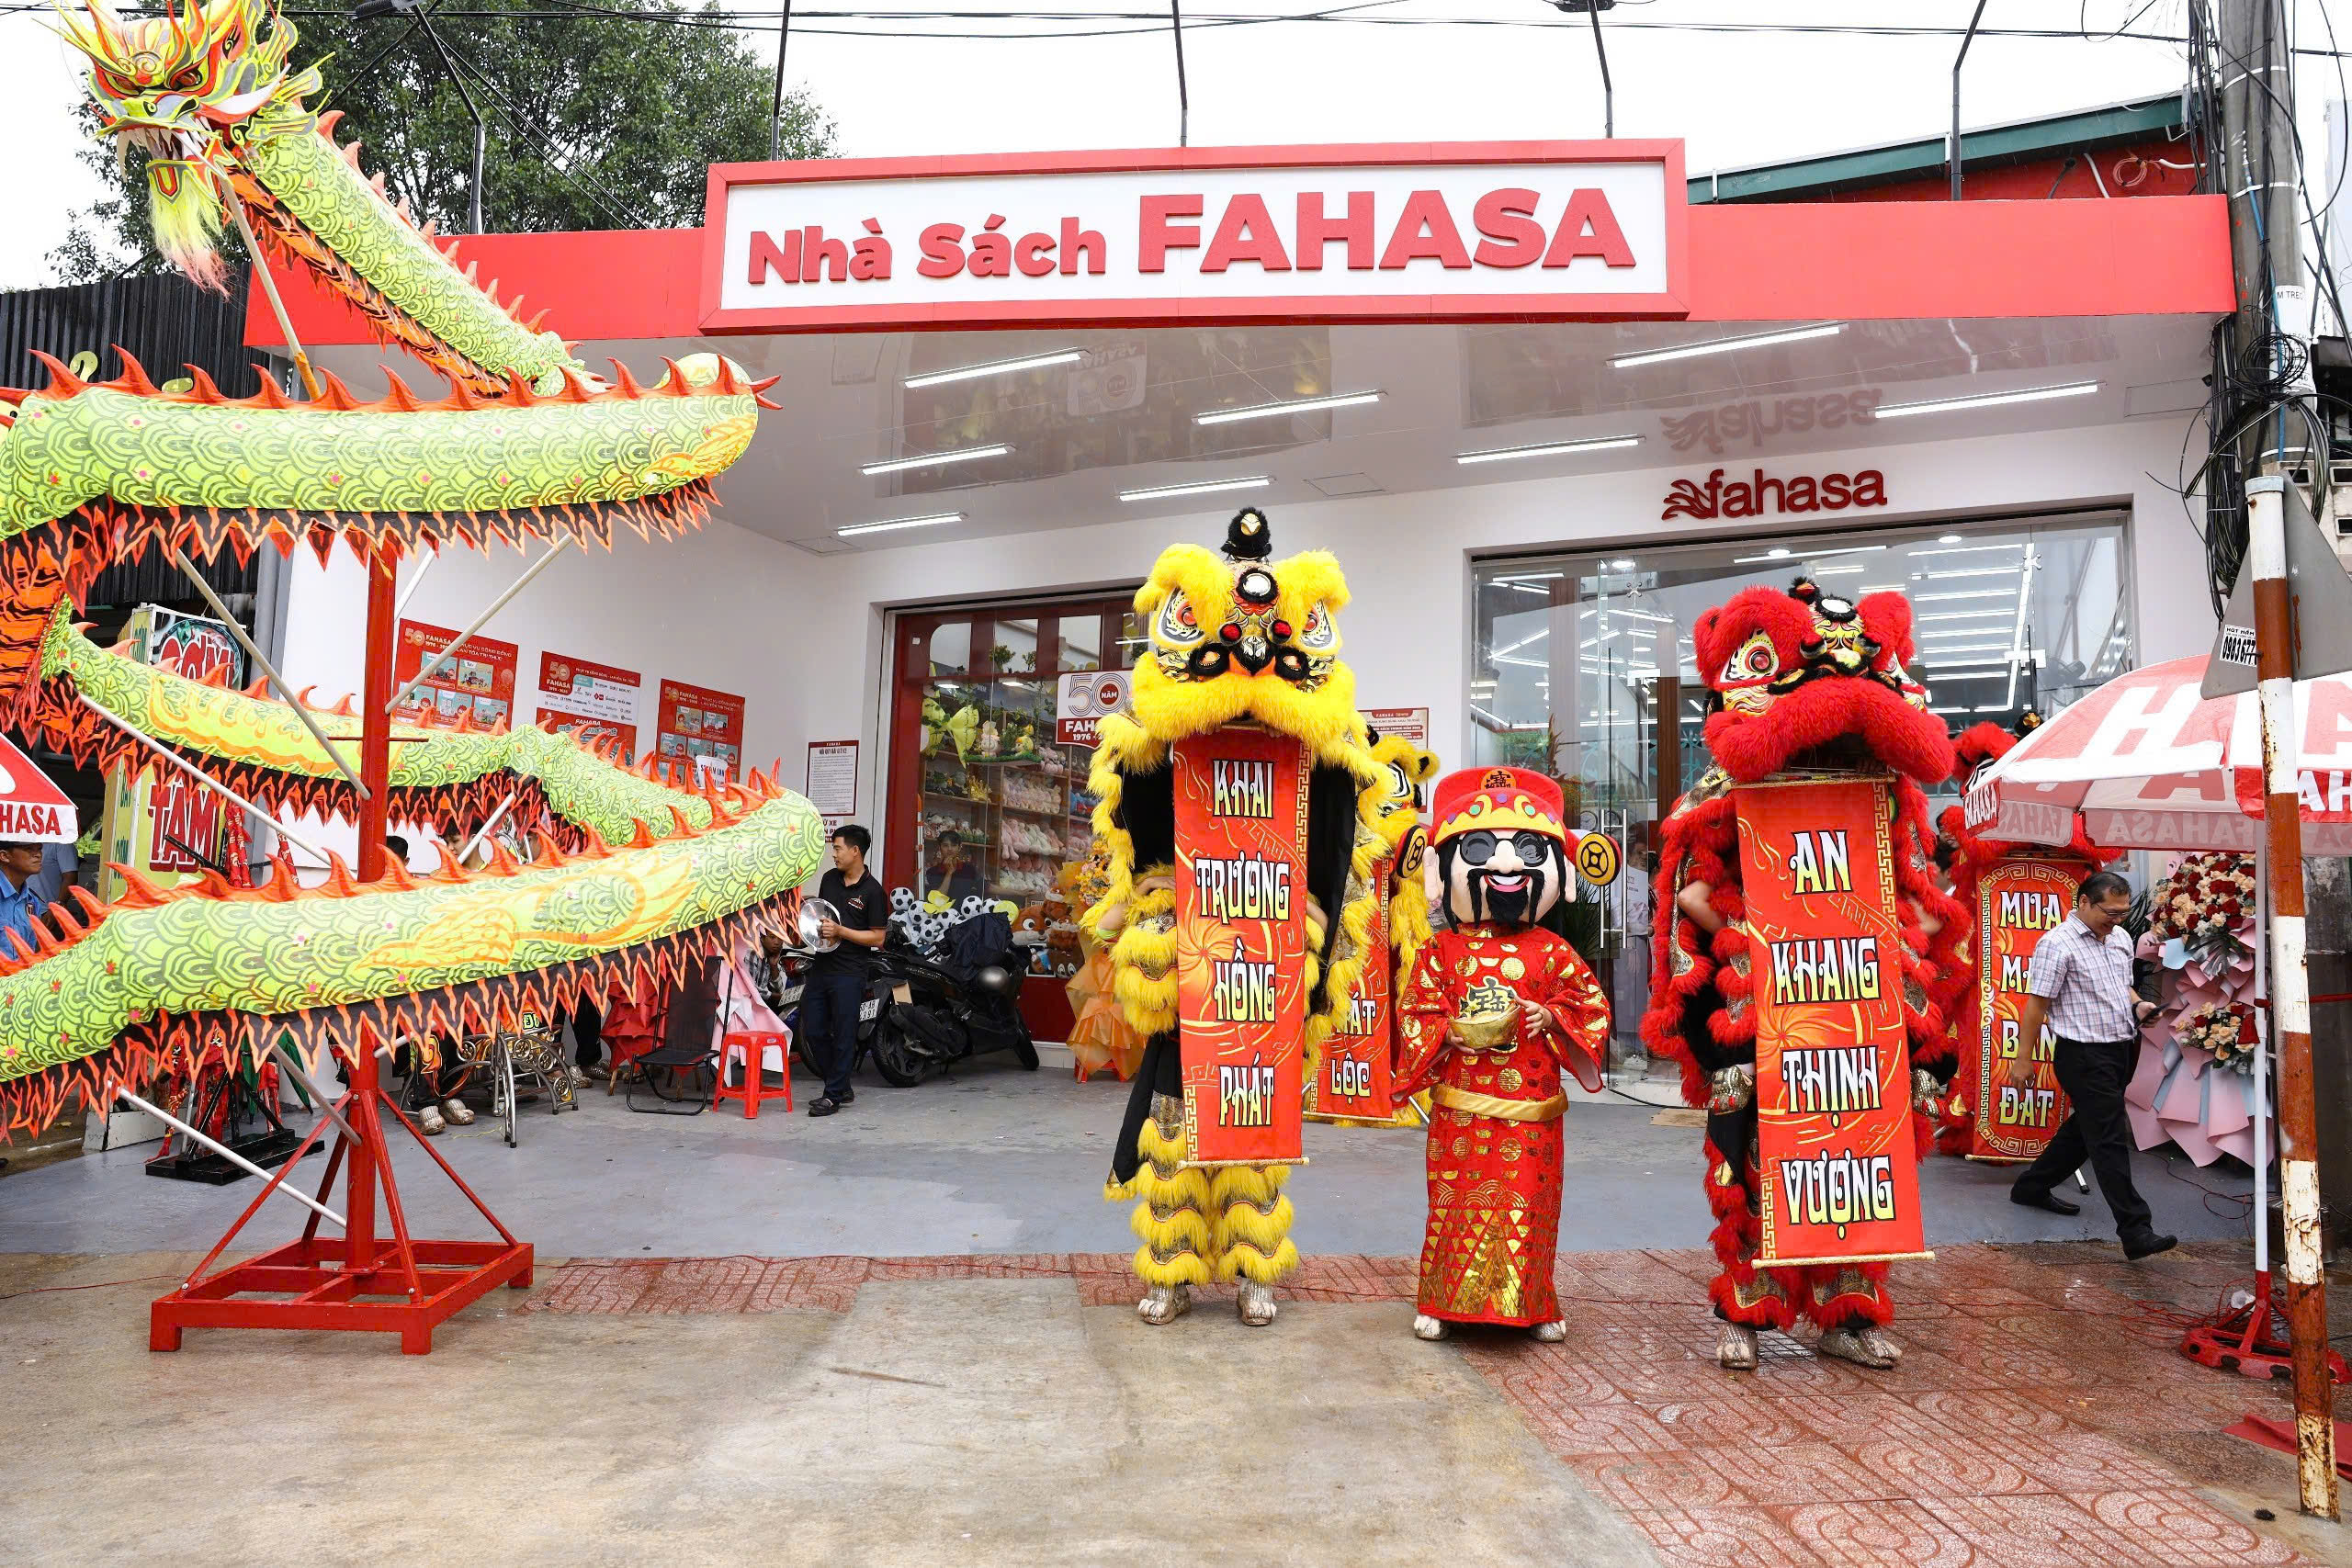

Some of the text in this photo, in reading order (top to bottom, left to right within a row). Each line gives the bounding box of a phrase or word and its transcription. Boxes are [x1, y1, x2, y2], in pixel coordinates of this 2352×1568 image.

[748, 186, 1636, 285] Nhà Sách FAHASA
[1705, 468, 1888, 518] fahasa
[425, 634, 452, 646] FAHASA
[546, 678, 571, 689] FAHASA
[1101, 691, 1117, 699] NĂM
[1066, 719, 1095, 733] FAH
[1212, 760, 1274, 820] KHAI
[1195, 851, 1291, 924] TRƯƠNG
[1790, 830, 1852, 896] AN
[1999, 891, 2062, 931] MUA
[1214, 937, 1277, 1023] HỒNG
[1769, 936, 1881, 1006] KHANG
[2001, 1020, 2057, 1062] BN
[1218, 1055, 1275, 1126] PHÁT
[1330, 1052, 1372, 1104] LỘC
[1781, 1045, 1882, 1129] THỊNH
[1781, 1148, 1896, 1240] VƯỢNG
